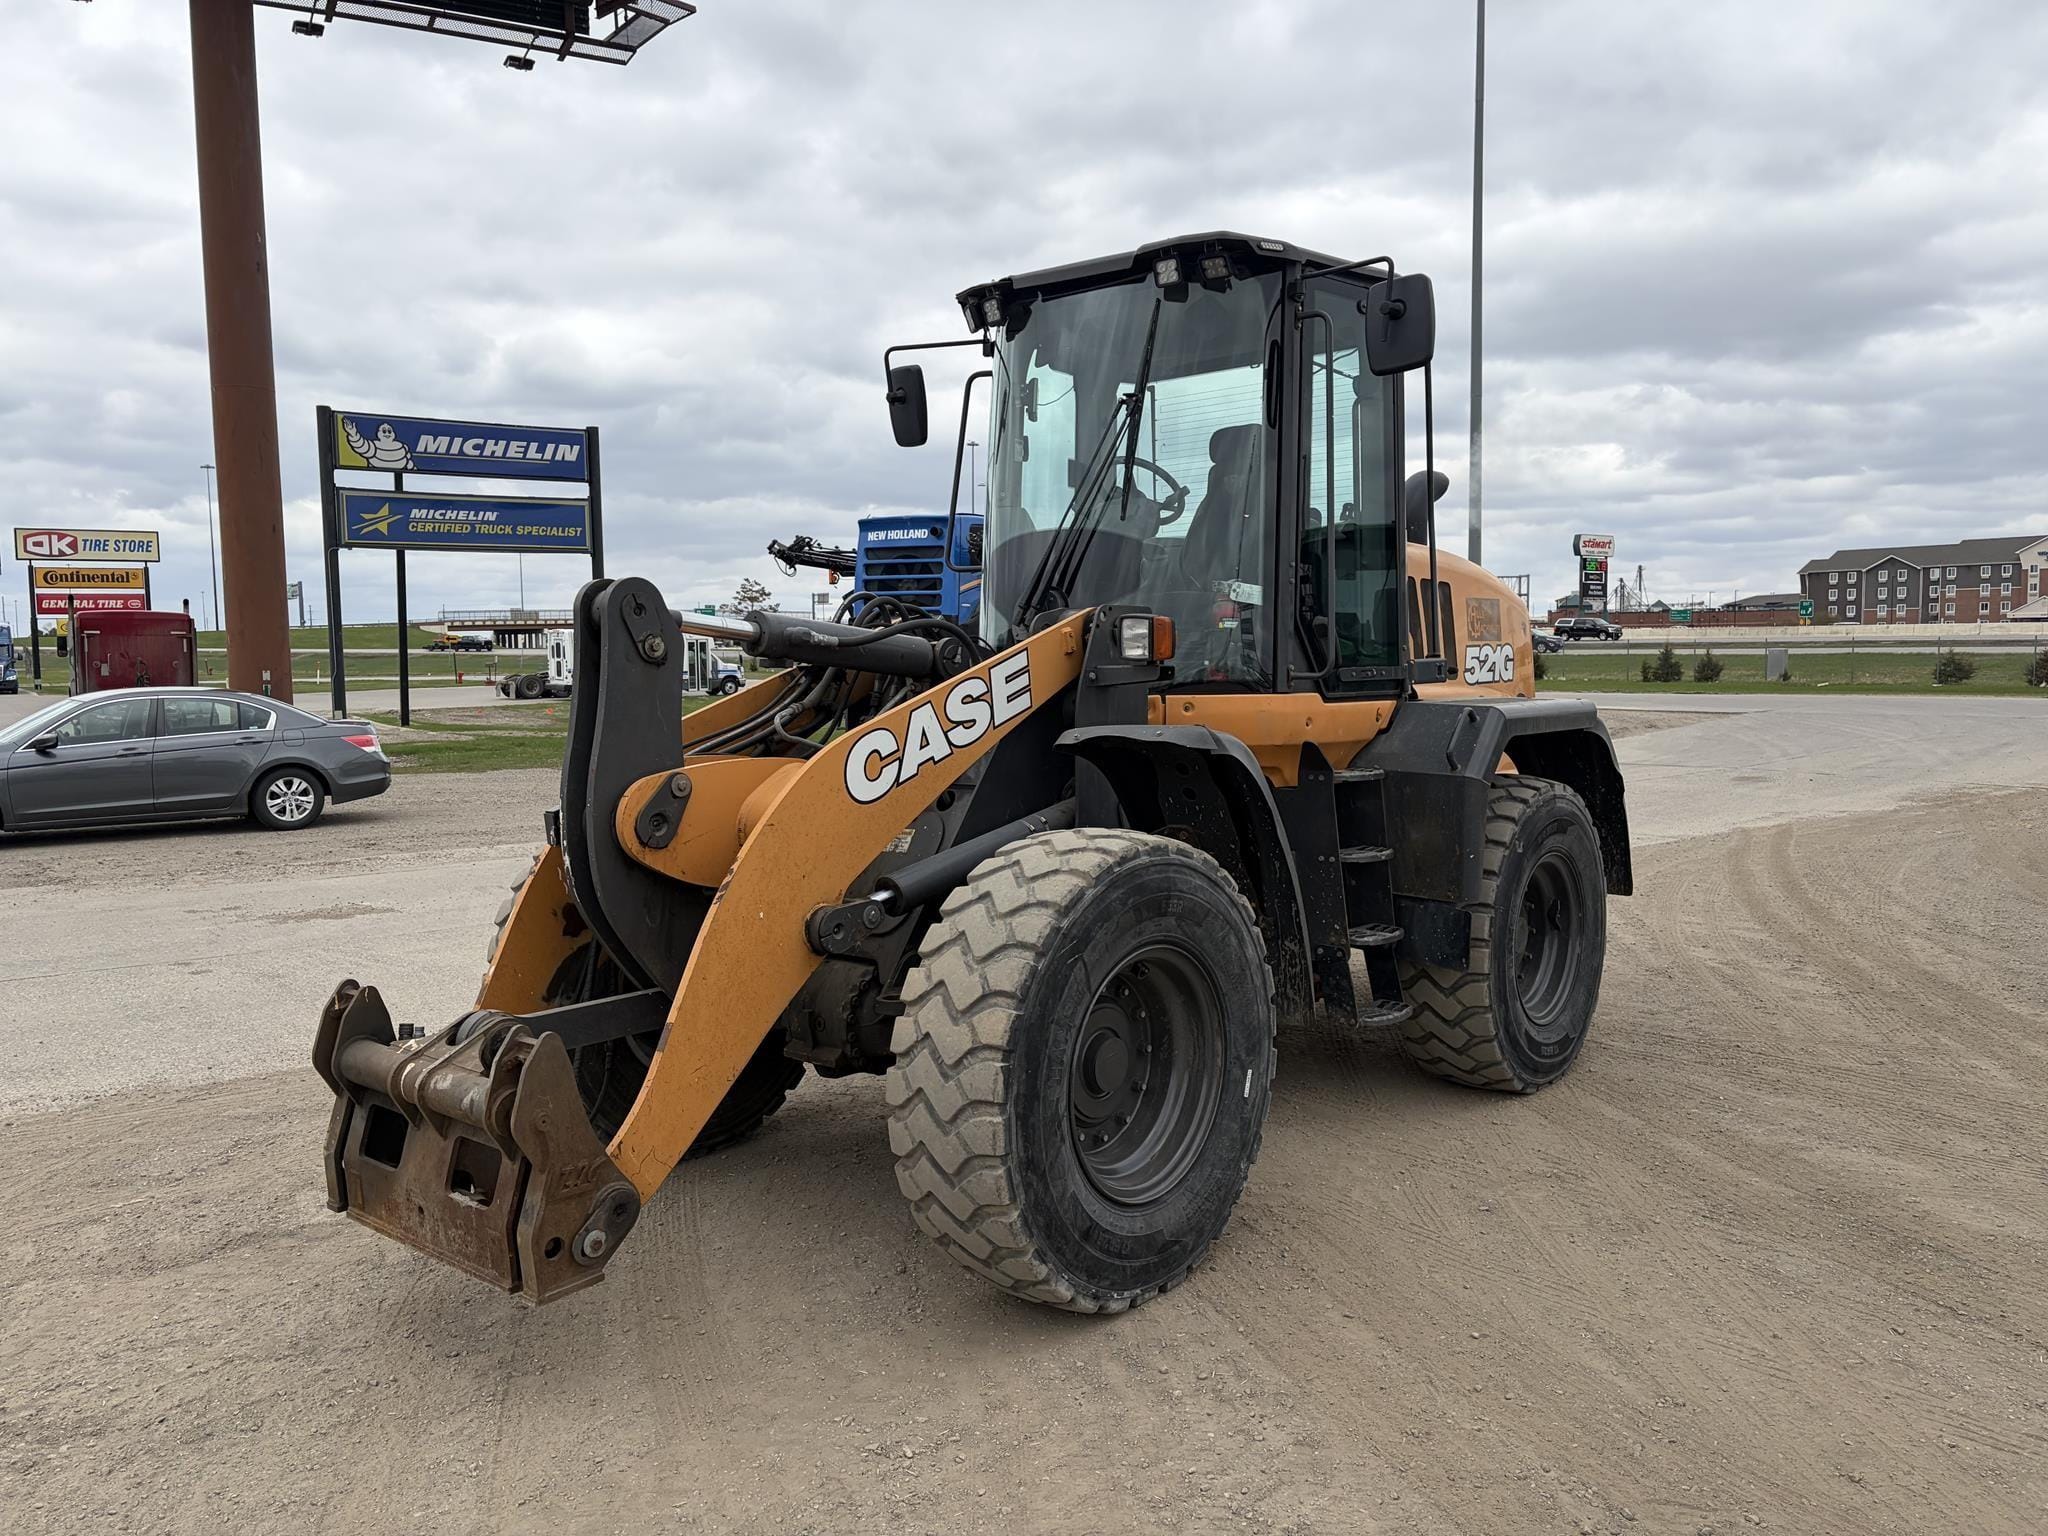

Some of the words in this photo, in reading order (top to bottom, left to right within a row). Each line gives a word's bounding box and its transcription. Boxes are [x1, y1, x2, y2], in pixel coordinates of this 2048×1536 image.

[416, 434, 580, 462] MICHELIN
[409, 508, 499, 521] MICHELIN
[408, 522, 472, 534] CERTIFIED
[474, 524, 513, 535] TRUCK
[516, 526, 583, 538] SPECIALIST
[867, 531, 887, 541] NEW
[887, 529, 929, 540] HOLLAND
[25, 534, 76, 556] OK
[81, 538, 111, 553] TIRE
[113, 539, 153, 553] STORE
[42, 570, 131, 586] Continental
[96, 599, 125, 609] TIRE
[1464, 643, 1515, 686] 521G
[844, 647, 1033, 805] CASE
